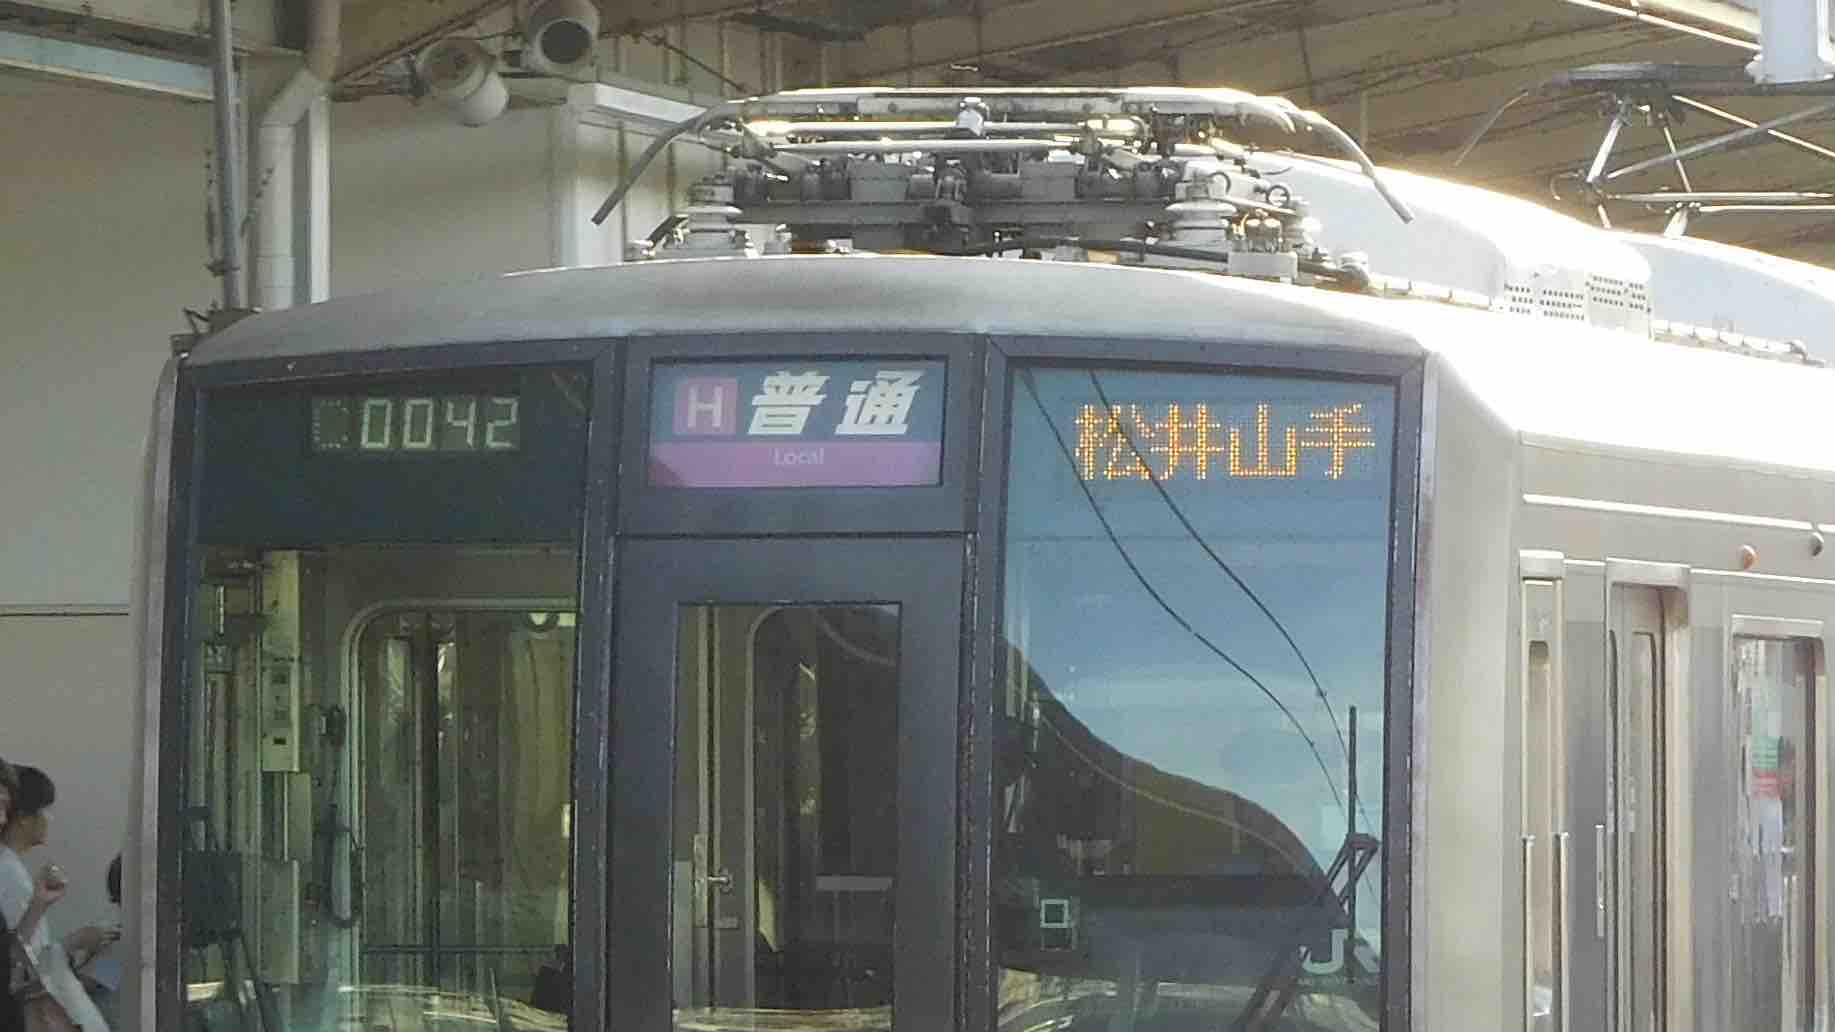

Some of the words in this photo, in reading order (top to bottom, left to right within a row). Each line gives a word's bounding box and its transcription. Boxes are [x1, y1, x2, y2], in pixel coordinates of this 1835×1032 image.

[686, 385, 723, 428] H
[747, 370, 926, 435] 普通
[773, 447, 825, 466] Local
[1074, 403, 1376, 480] 松井山手
